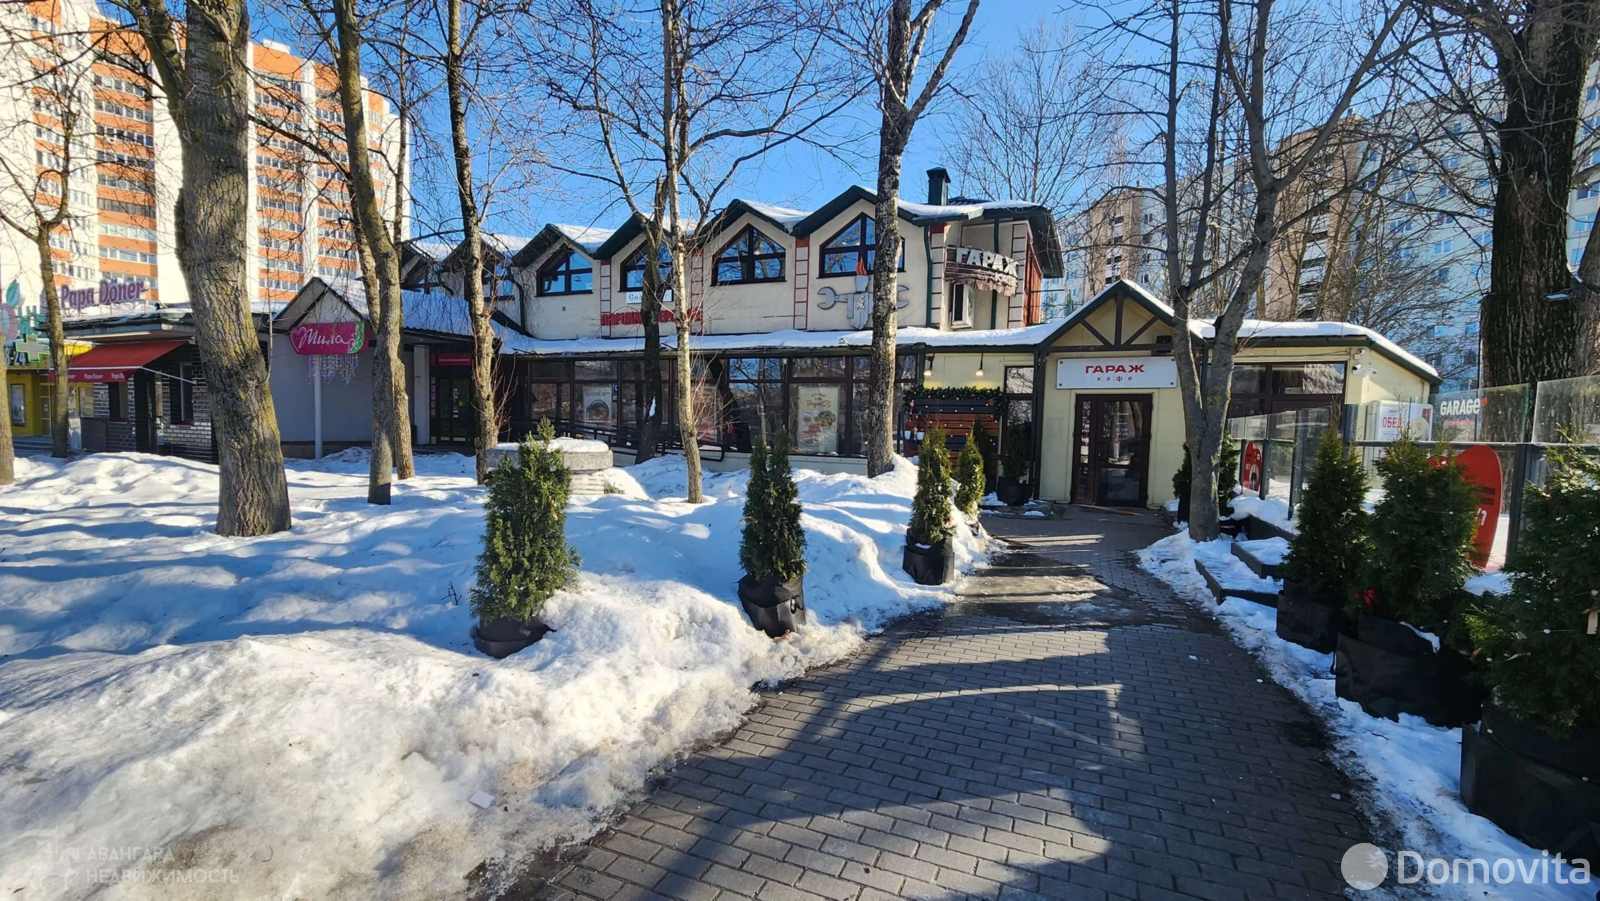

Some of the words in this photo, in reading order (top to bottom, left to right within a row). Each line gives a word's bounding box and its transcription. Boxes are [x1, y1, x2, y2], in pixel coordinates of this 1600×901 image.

[956, 246, 1020, 278] ГАРАЖ
[60, 284, 95, 313] Papa
[98, 277, 145, 304] Döner
[298, 328, 348, 349] Мила
[1085, 364, 1145, 374] ГАРАЖ
